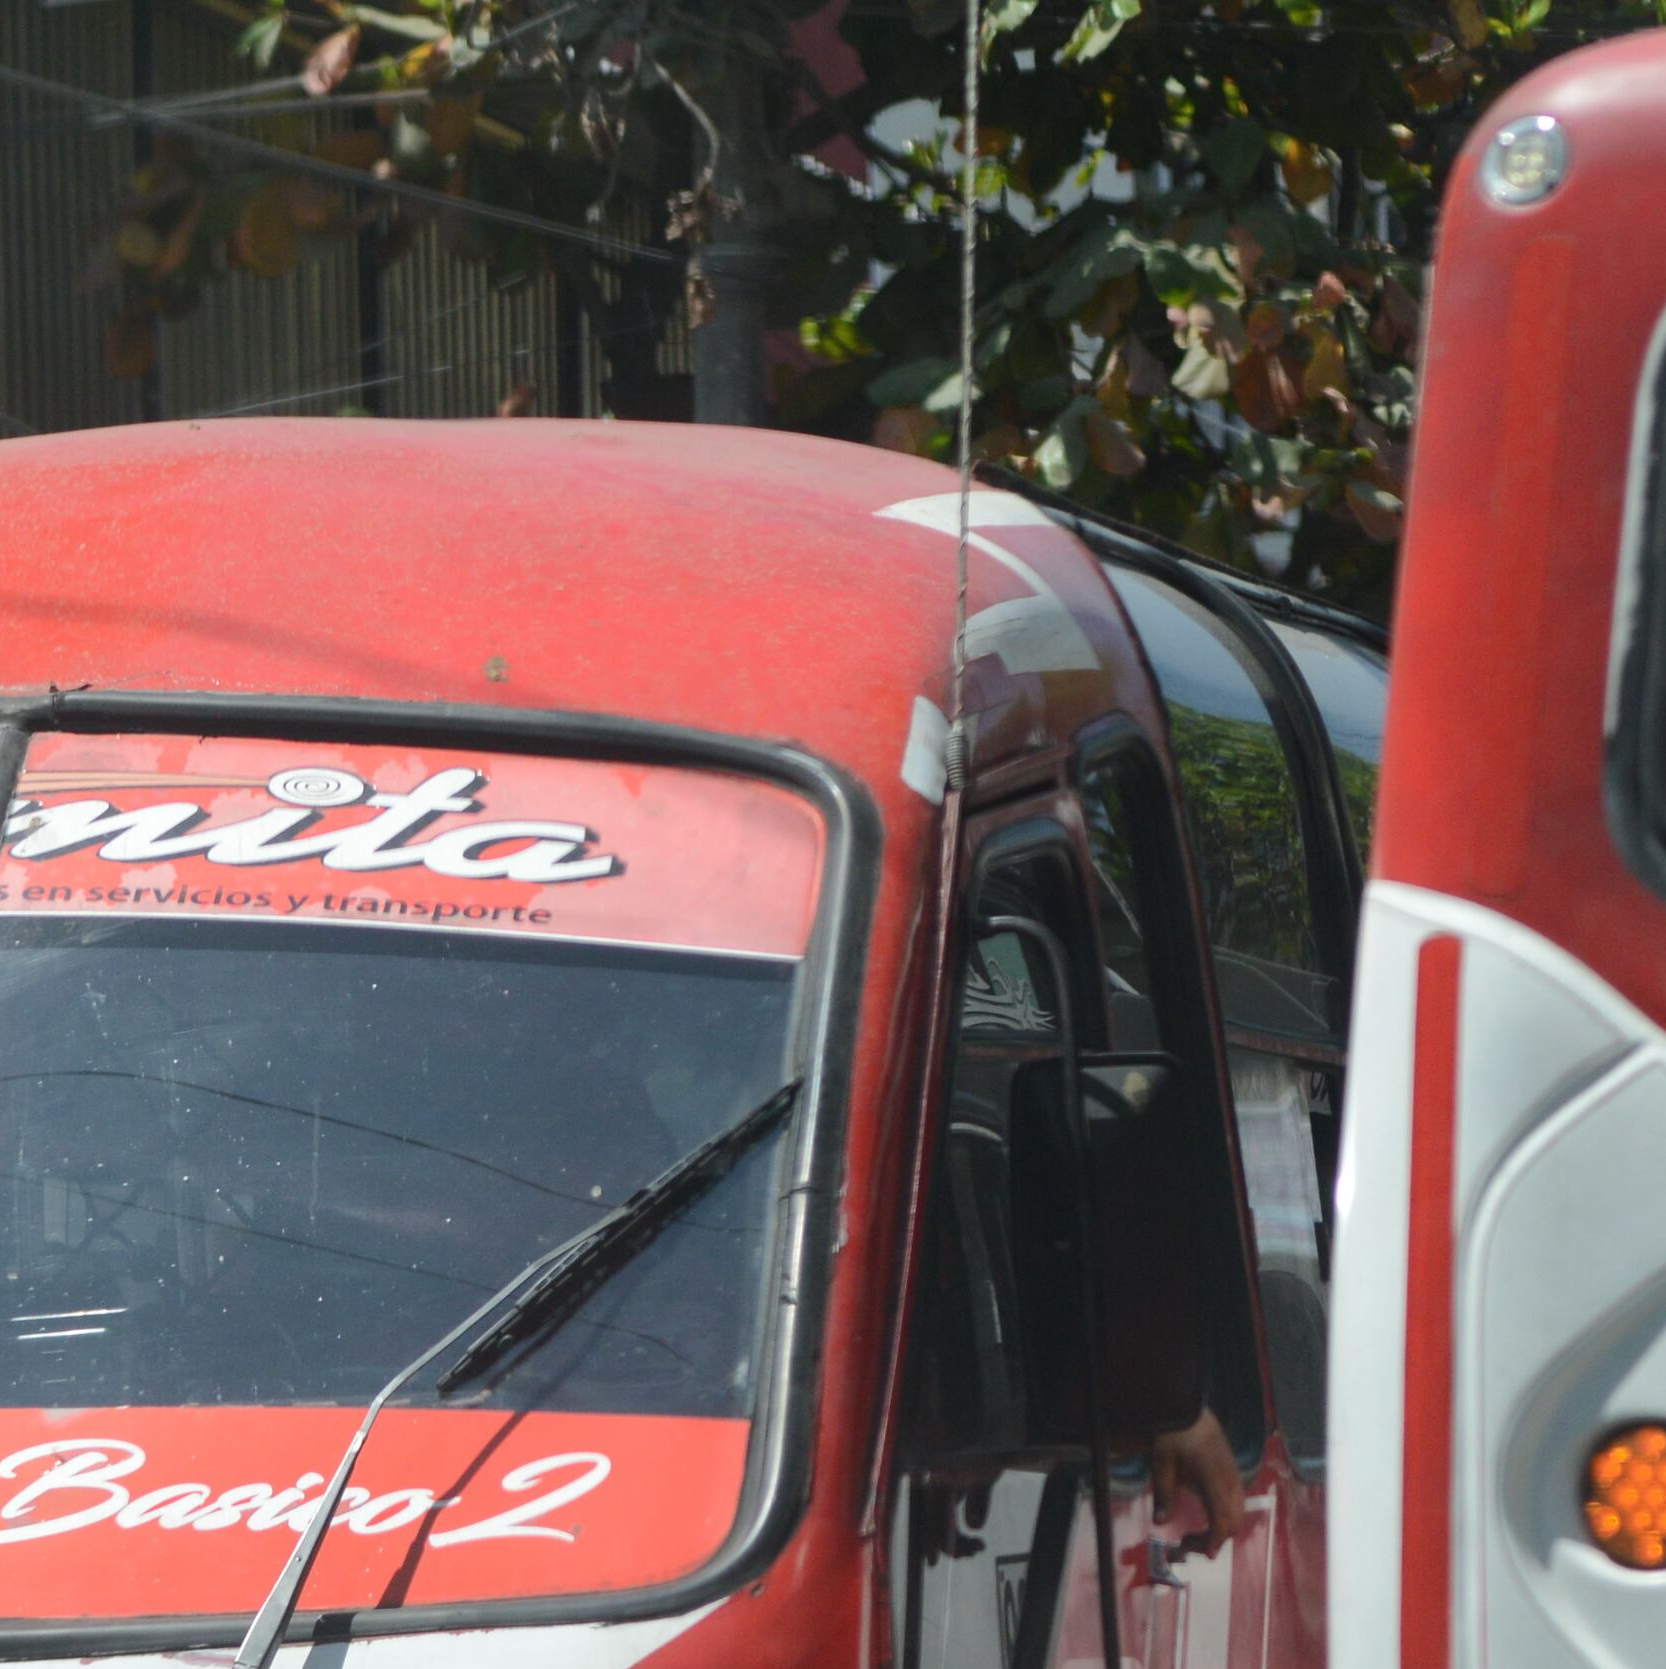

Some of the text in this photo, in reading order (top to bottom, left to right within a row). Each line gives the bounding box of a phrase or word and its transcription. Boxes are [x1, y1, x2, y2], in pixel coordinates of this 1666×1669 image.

[29, 883, 73, 903] en
[89, 882, 271, 908] servicios
[287, 893, 308, 913] y
[323, 889, 552, 925] transporte
[429, 1452, 611, 1548] 2
